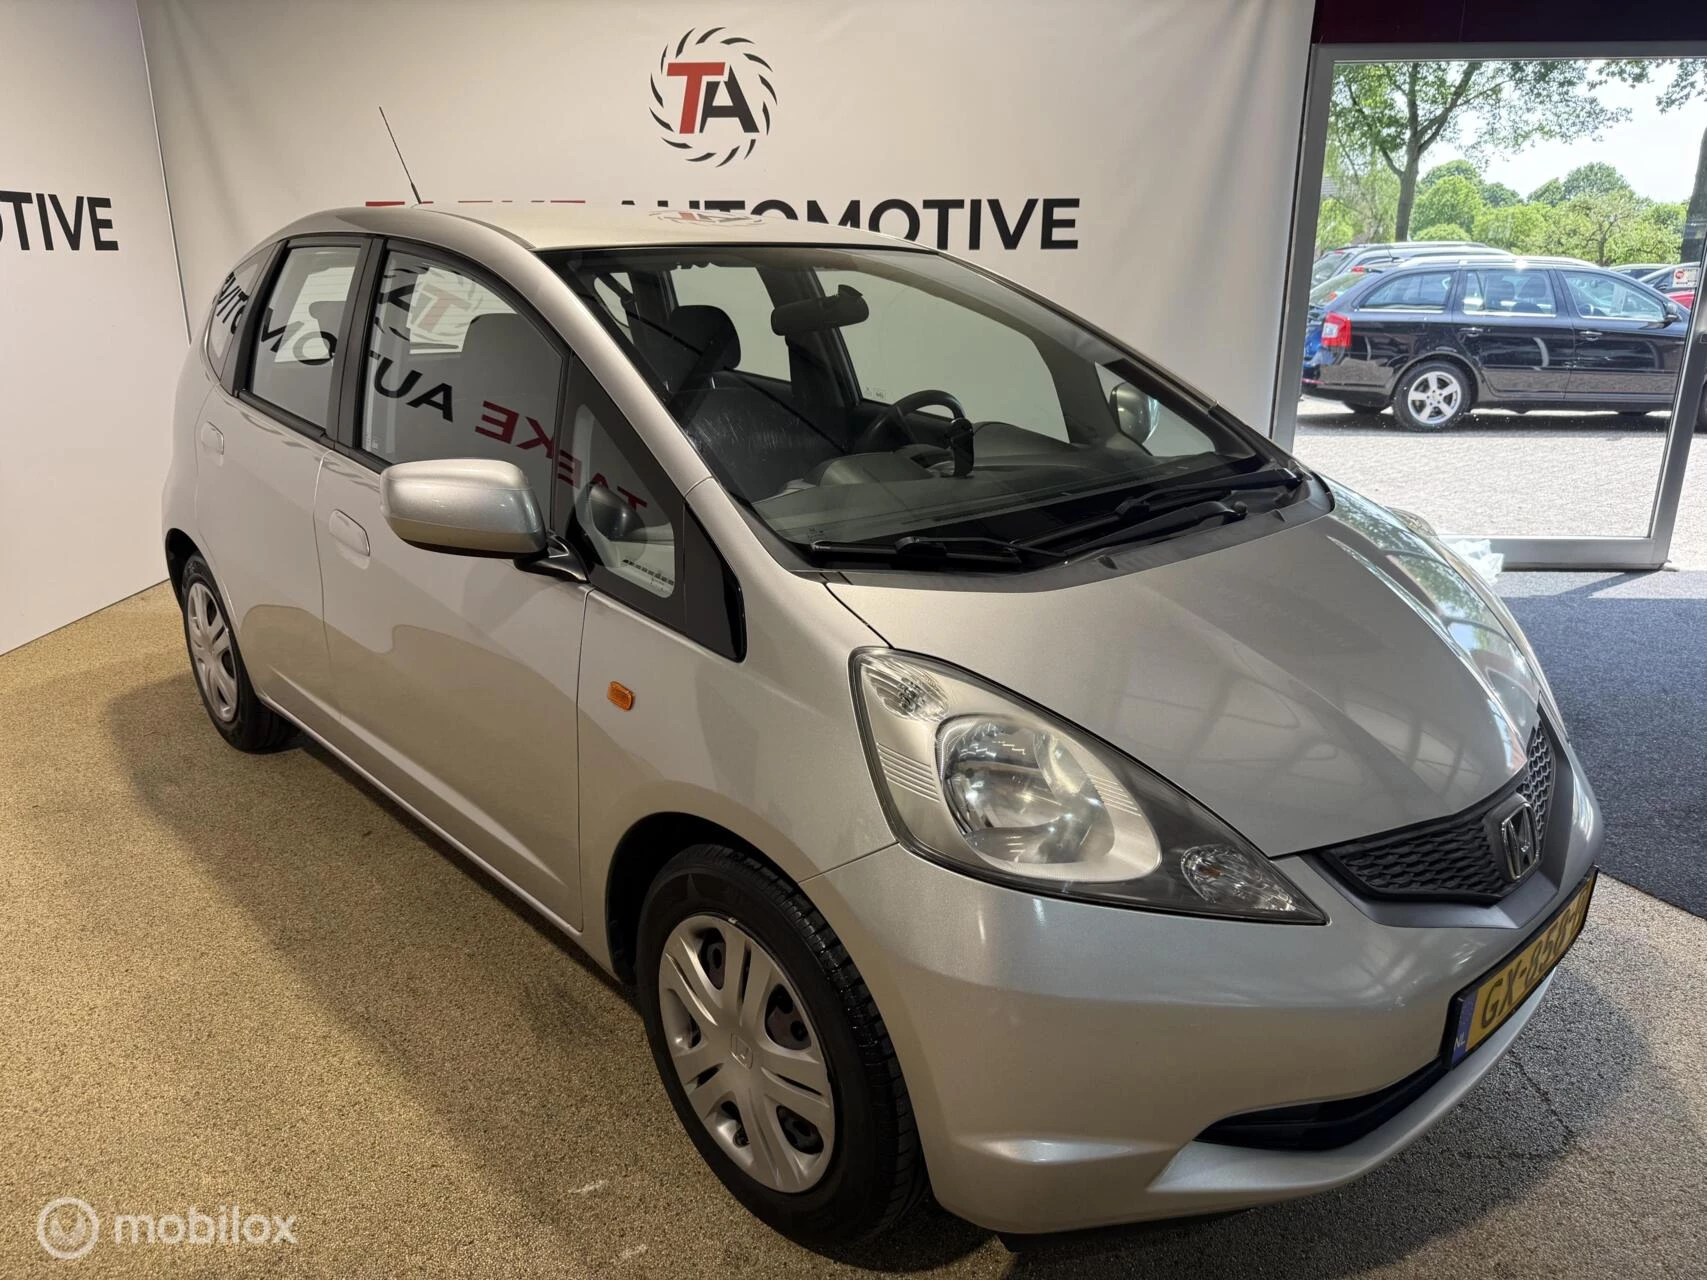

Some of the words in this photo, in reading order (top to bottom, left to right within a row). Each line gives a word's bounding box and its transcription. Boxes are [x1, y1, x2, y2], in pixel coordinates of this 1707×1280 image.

[667, 62, 760, 134] TA
[0, 190, 119, 251] TIVE
[621, 198, 1080, 250] MOTIVE
[1454, 1031, 1466, 1052] NL
